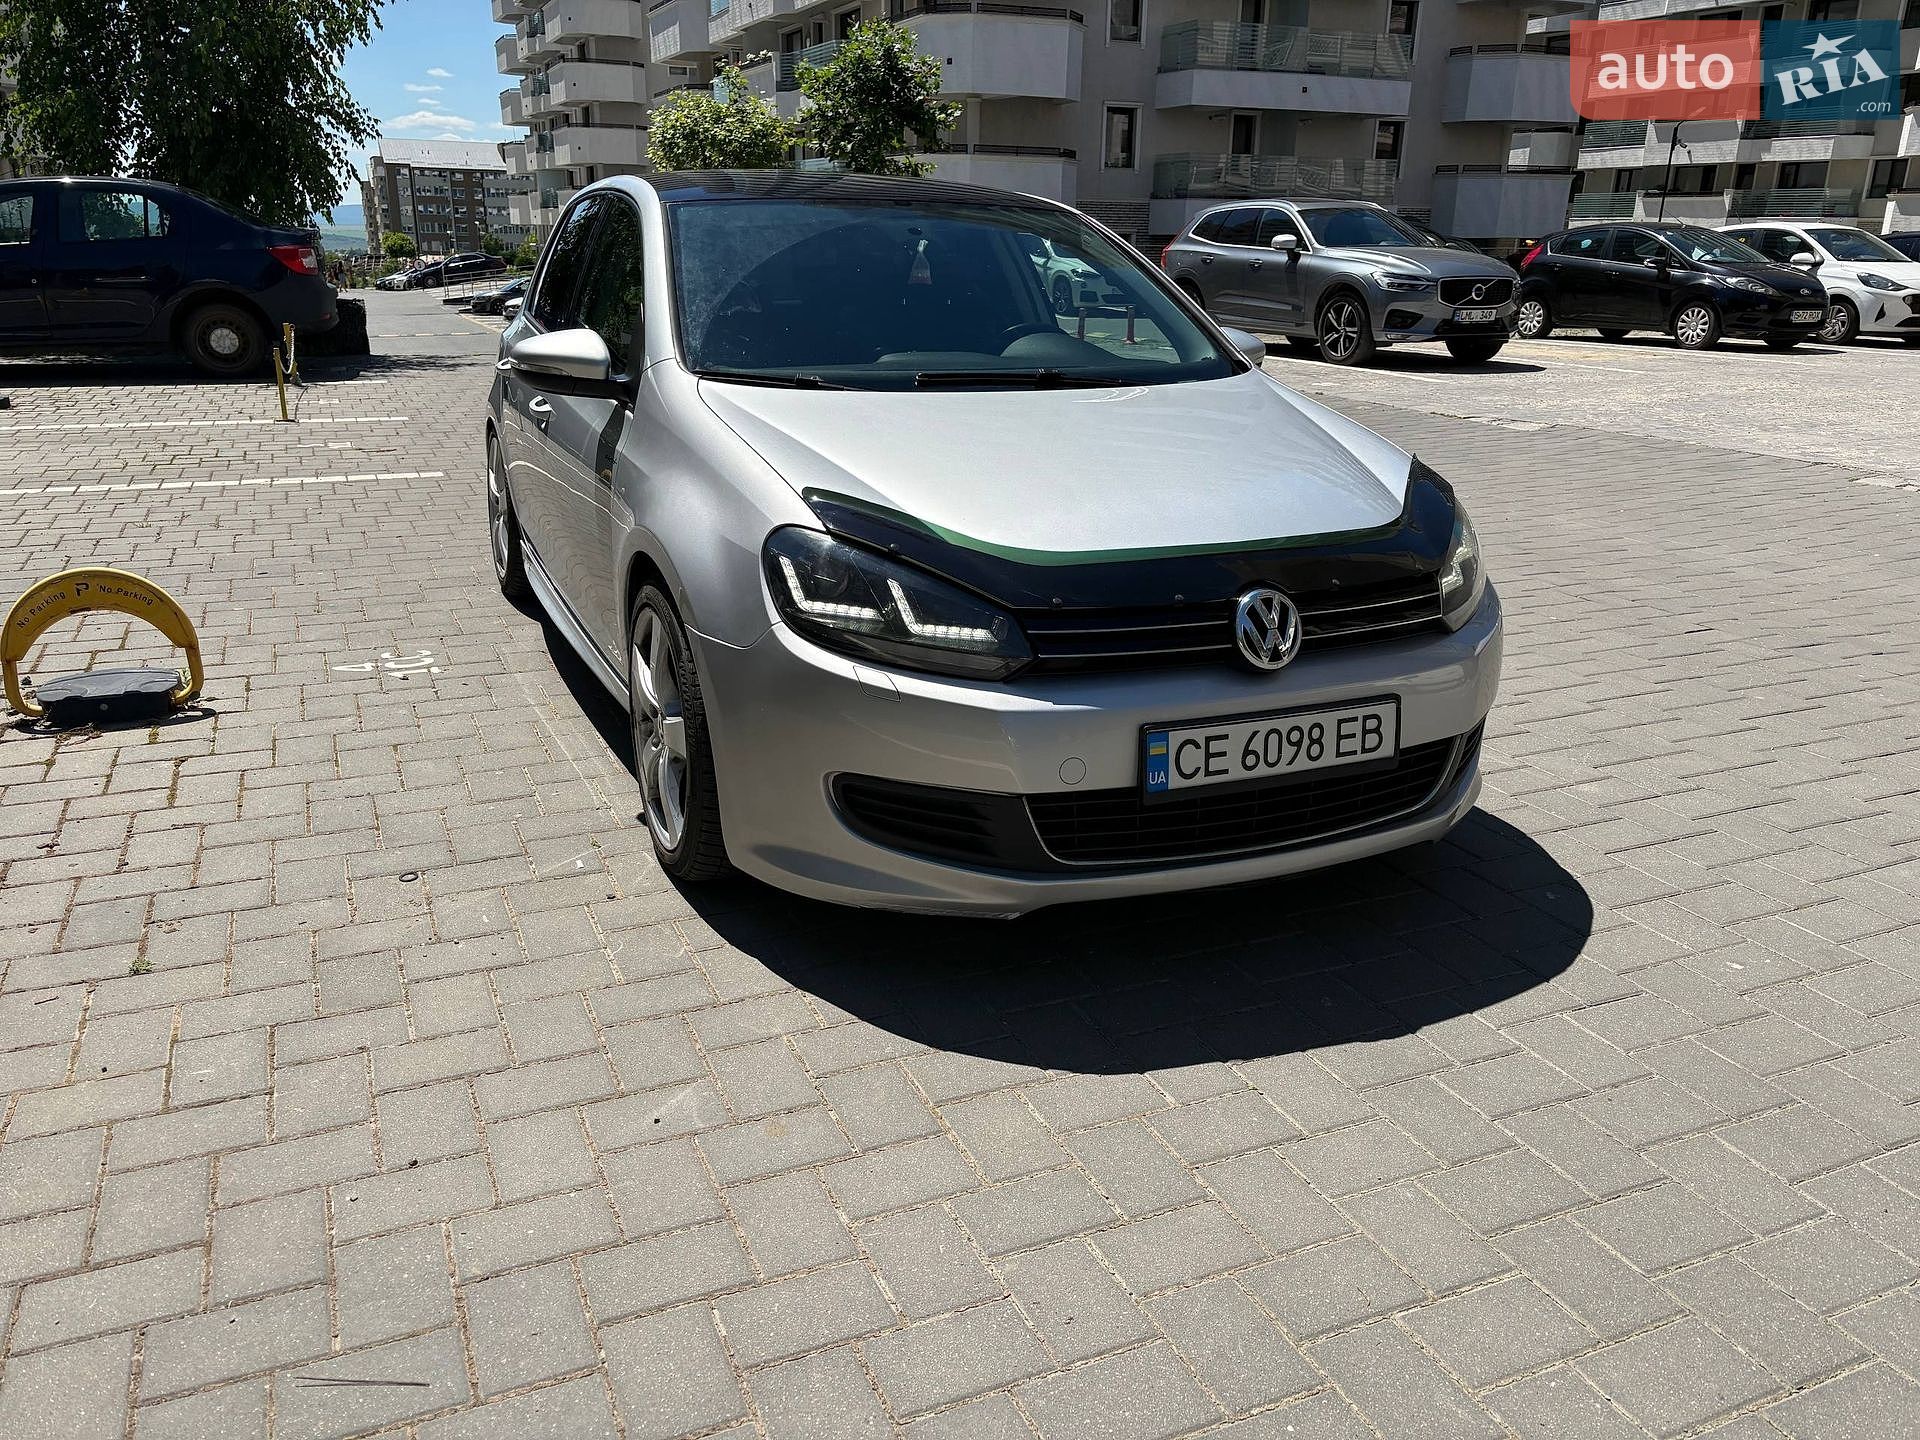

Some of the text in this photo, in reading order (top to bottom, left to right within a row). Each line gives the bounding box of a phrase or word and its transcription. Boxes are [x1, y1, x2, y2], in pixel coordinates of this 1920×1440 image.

[16, 582, 154, 629] No Parking P No Parking
[1174, 713, 1384, 780] CE 6098 EB
[1149, 771, 1167, 785] UA
